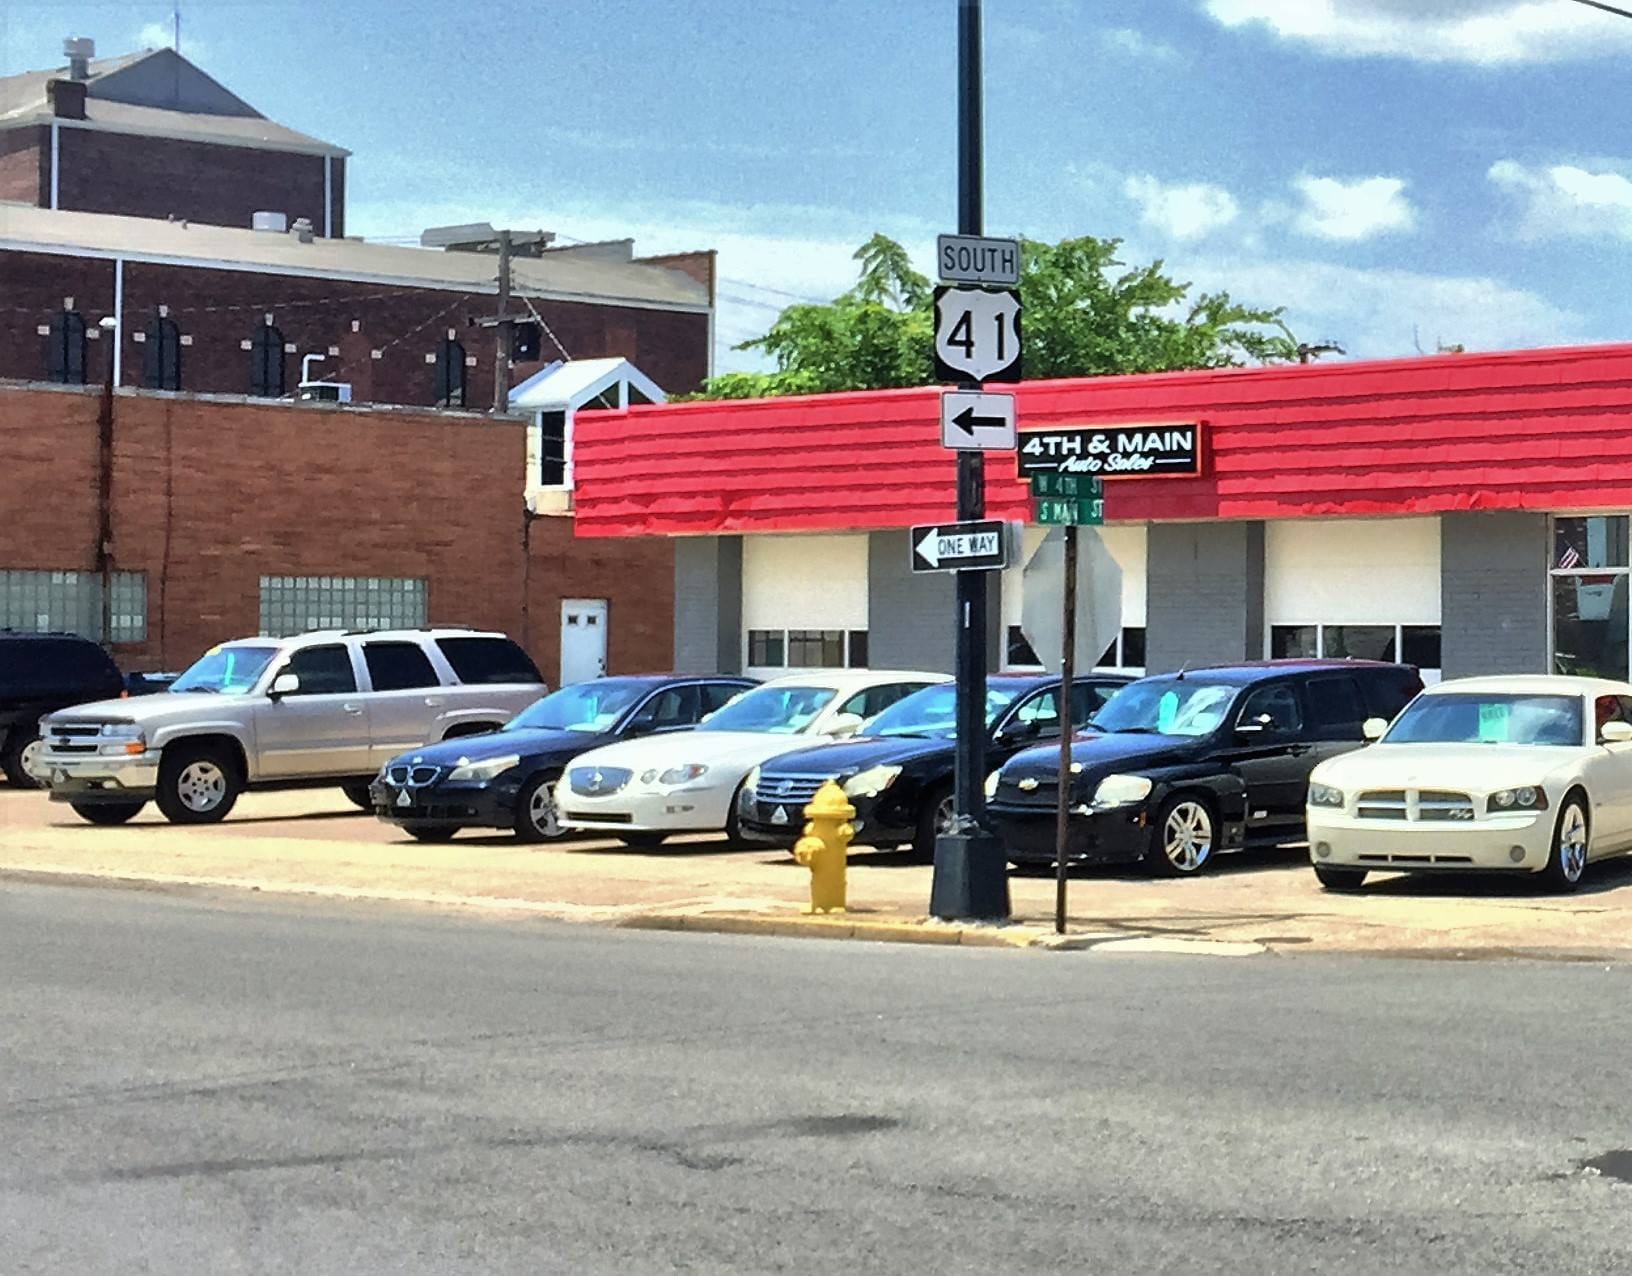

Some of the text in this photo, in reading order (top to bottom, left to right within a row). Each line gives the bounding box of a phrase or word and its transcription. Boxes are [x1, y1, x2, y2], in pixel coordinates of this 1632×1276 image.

[944, 245, 1014, 274] SOUTH
[946, 310, 1005, 361] 41
[1022, 431, 1192, 456] 4TH & MAIN
[1058, 453, 1155, 473] Auto Sales
[1055, 476, 1078, 495] 4TH
[1040, 501, 1049, 520] S
[1090, 499, 1104, 518] ST
[938, 535, 995, 556] ONE WAY
